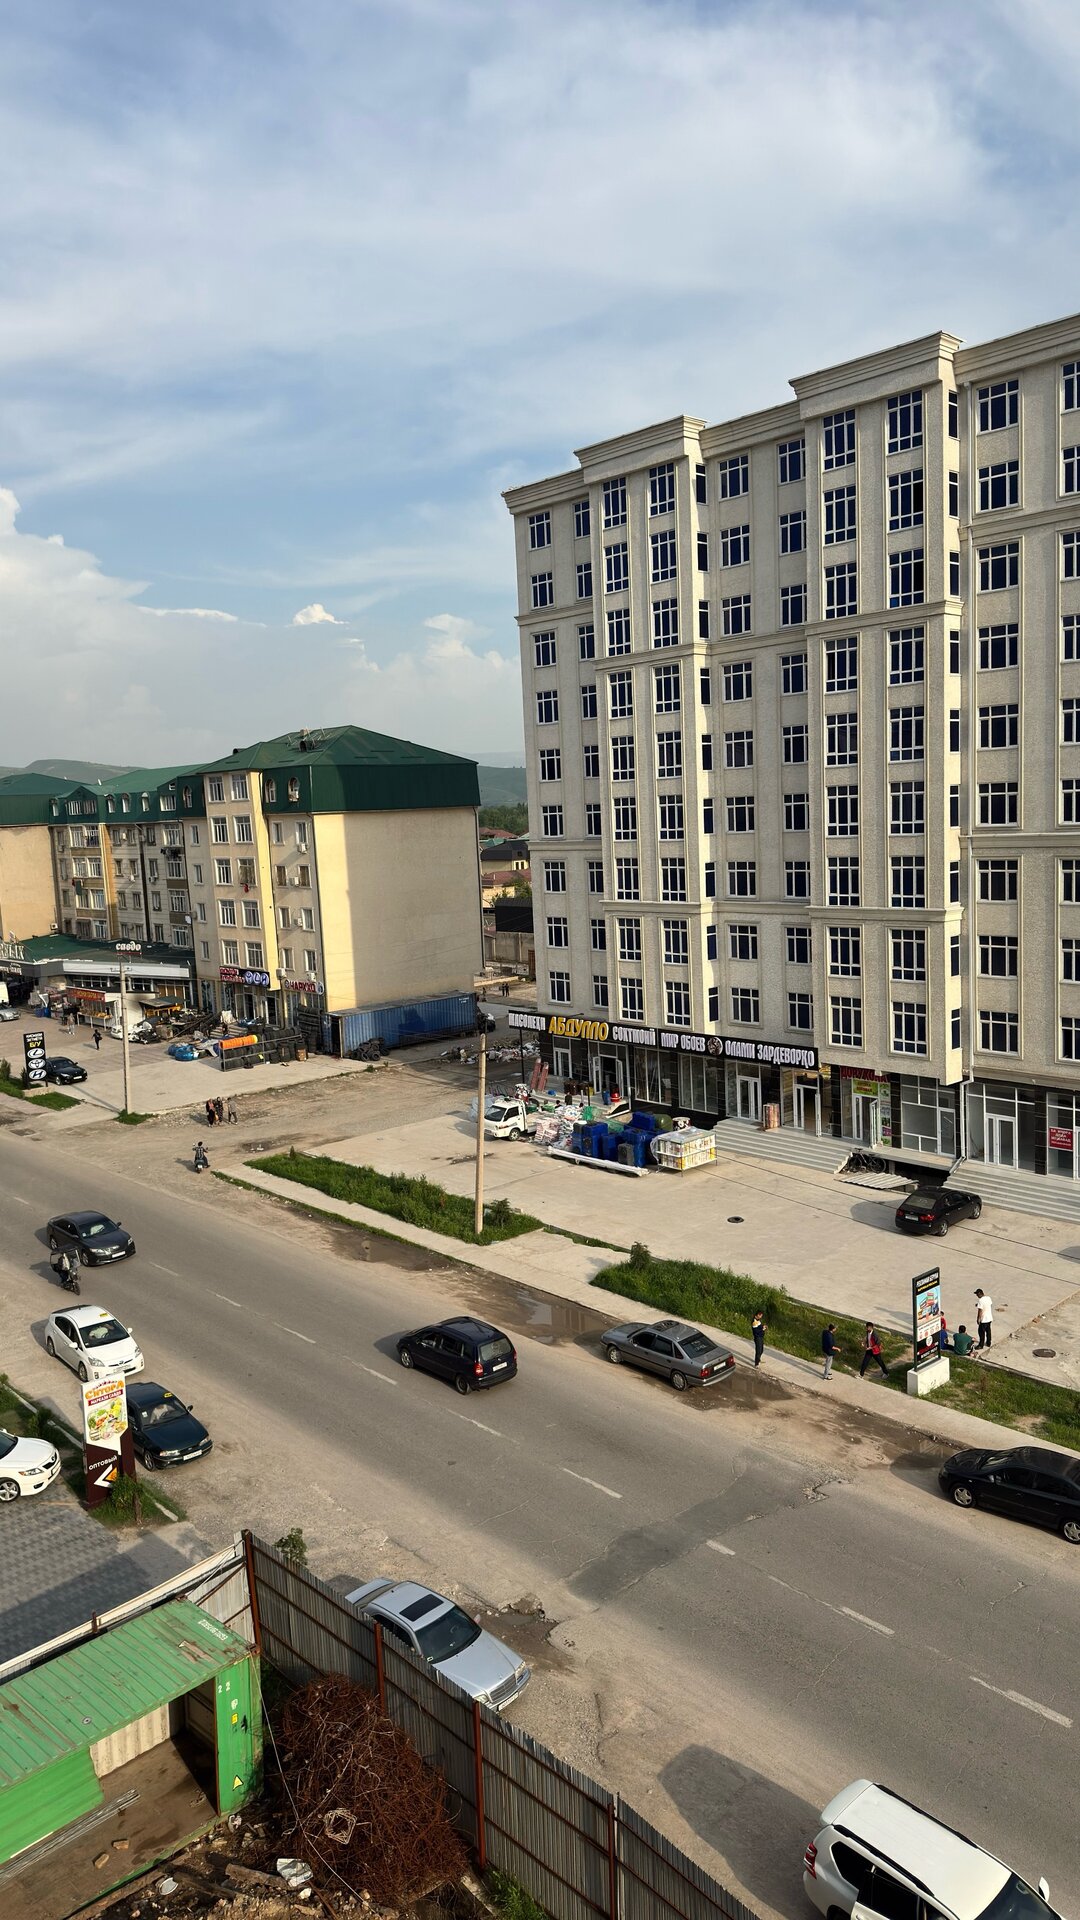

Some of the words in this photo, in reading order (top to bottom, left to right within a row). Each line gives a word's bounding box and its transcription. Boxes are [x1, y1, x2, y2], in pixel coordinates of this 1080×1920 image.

[548, 1016, 609, 1041] АБДУЛЛО
[660, 1032, 679, 1049] МИР
[680, 1034, 706, 1053] ОБОЕВ
[725, 1039, 756, 1059] ОЛАМИ
[88, 1455, 118, 1470] ОПТОВЫЙ
